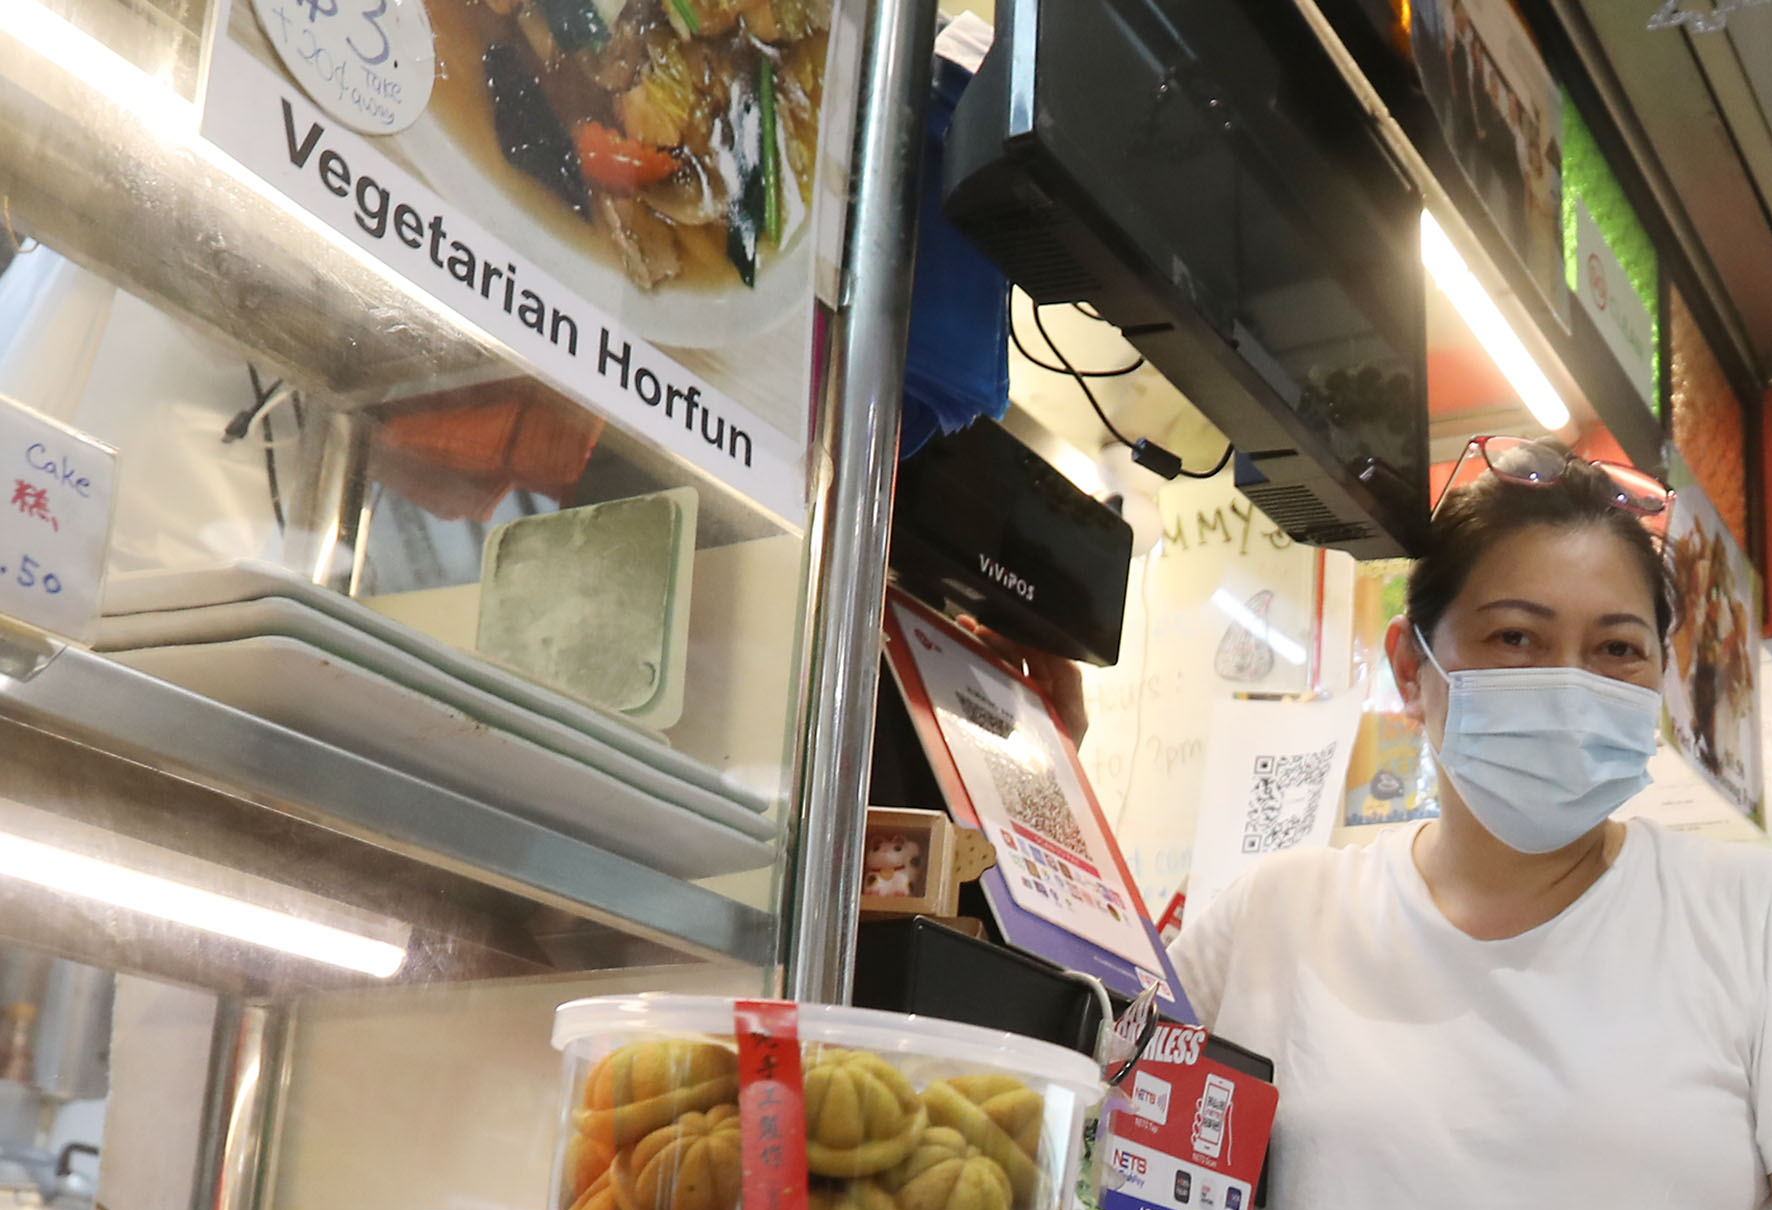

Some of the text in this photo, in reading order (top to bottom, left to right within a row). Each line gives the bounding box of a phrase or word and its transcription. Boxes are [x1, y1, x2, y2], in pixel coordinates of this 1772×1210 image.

[281, 96, 752, 468] Vegetarian Horfun
[26, 442, 91, 498] Cake
